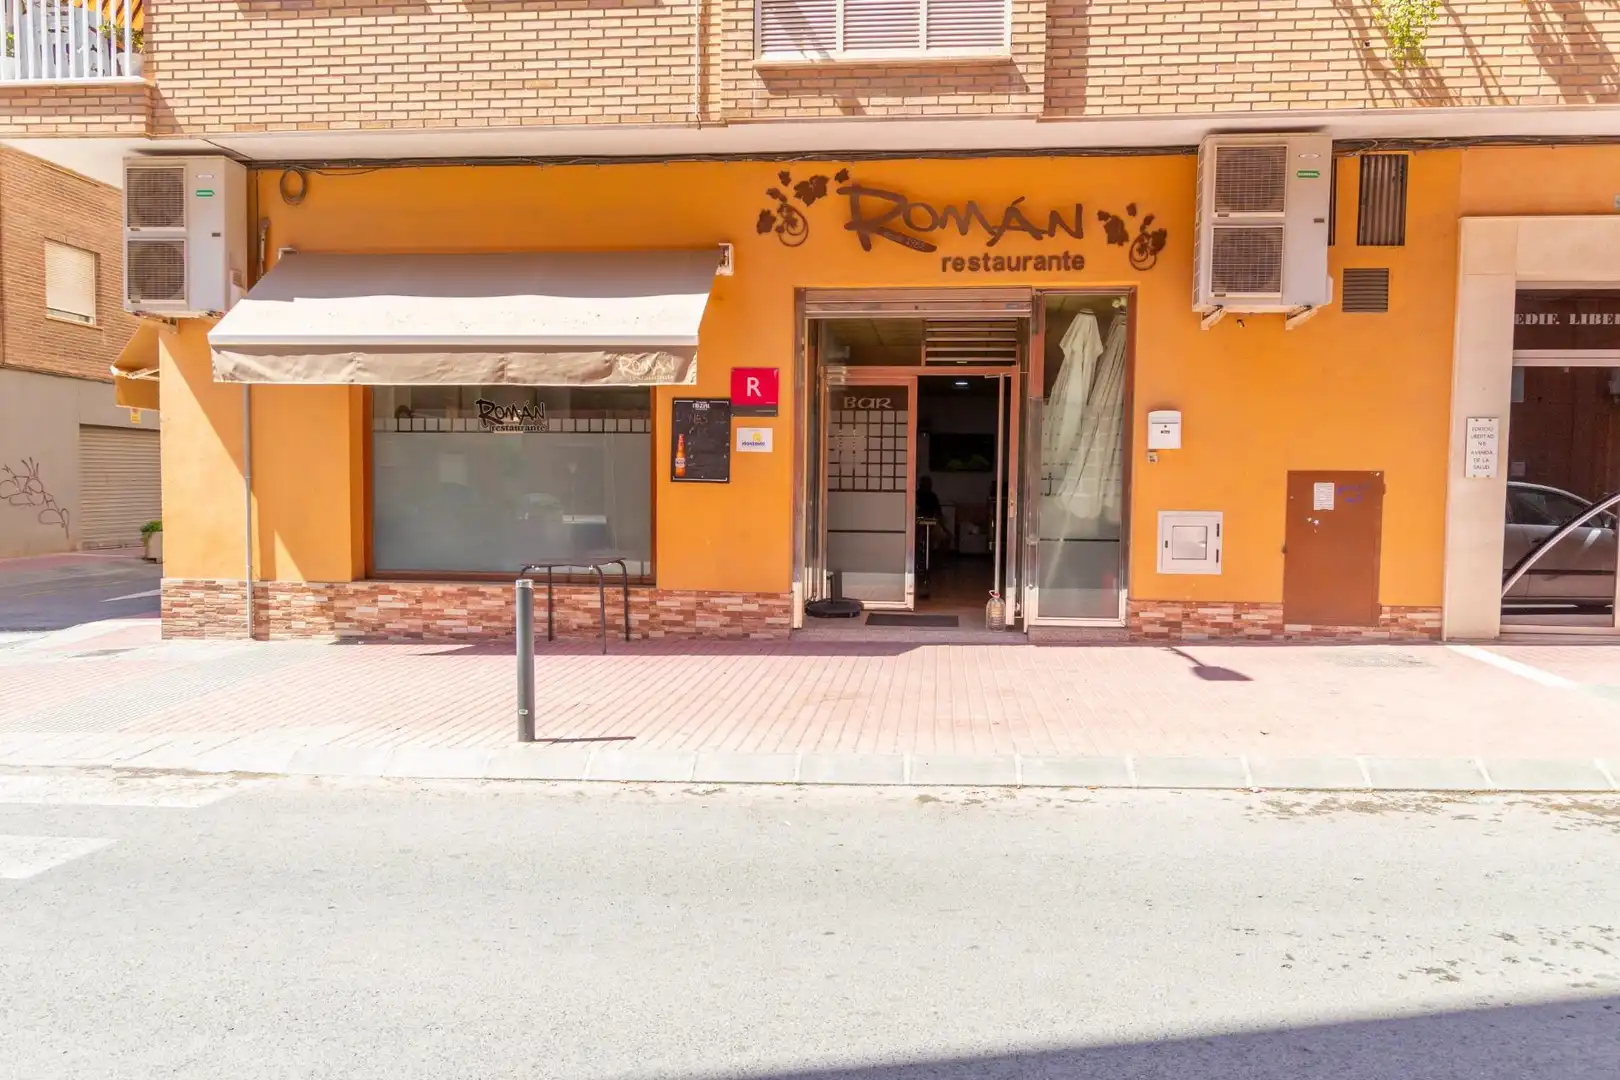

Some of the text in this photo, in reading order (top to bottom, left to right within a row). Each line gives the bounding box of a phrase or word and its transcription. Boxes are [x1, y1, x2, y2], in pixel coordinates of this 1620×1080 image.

[941, 251, 1085, 273] restaurante
[1514, 313, 1560, 325] EDIF.
[747, 376, 761, 397] R
[491, 424, 546, 432] restaurante
